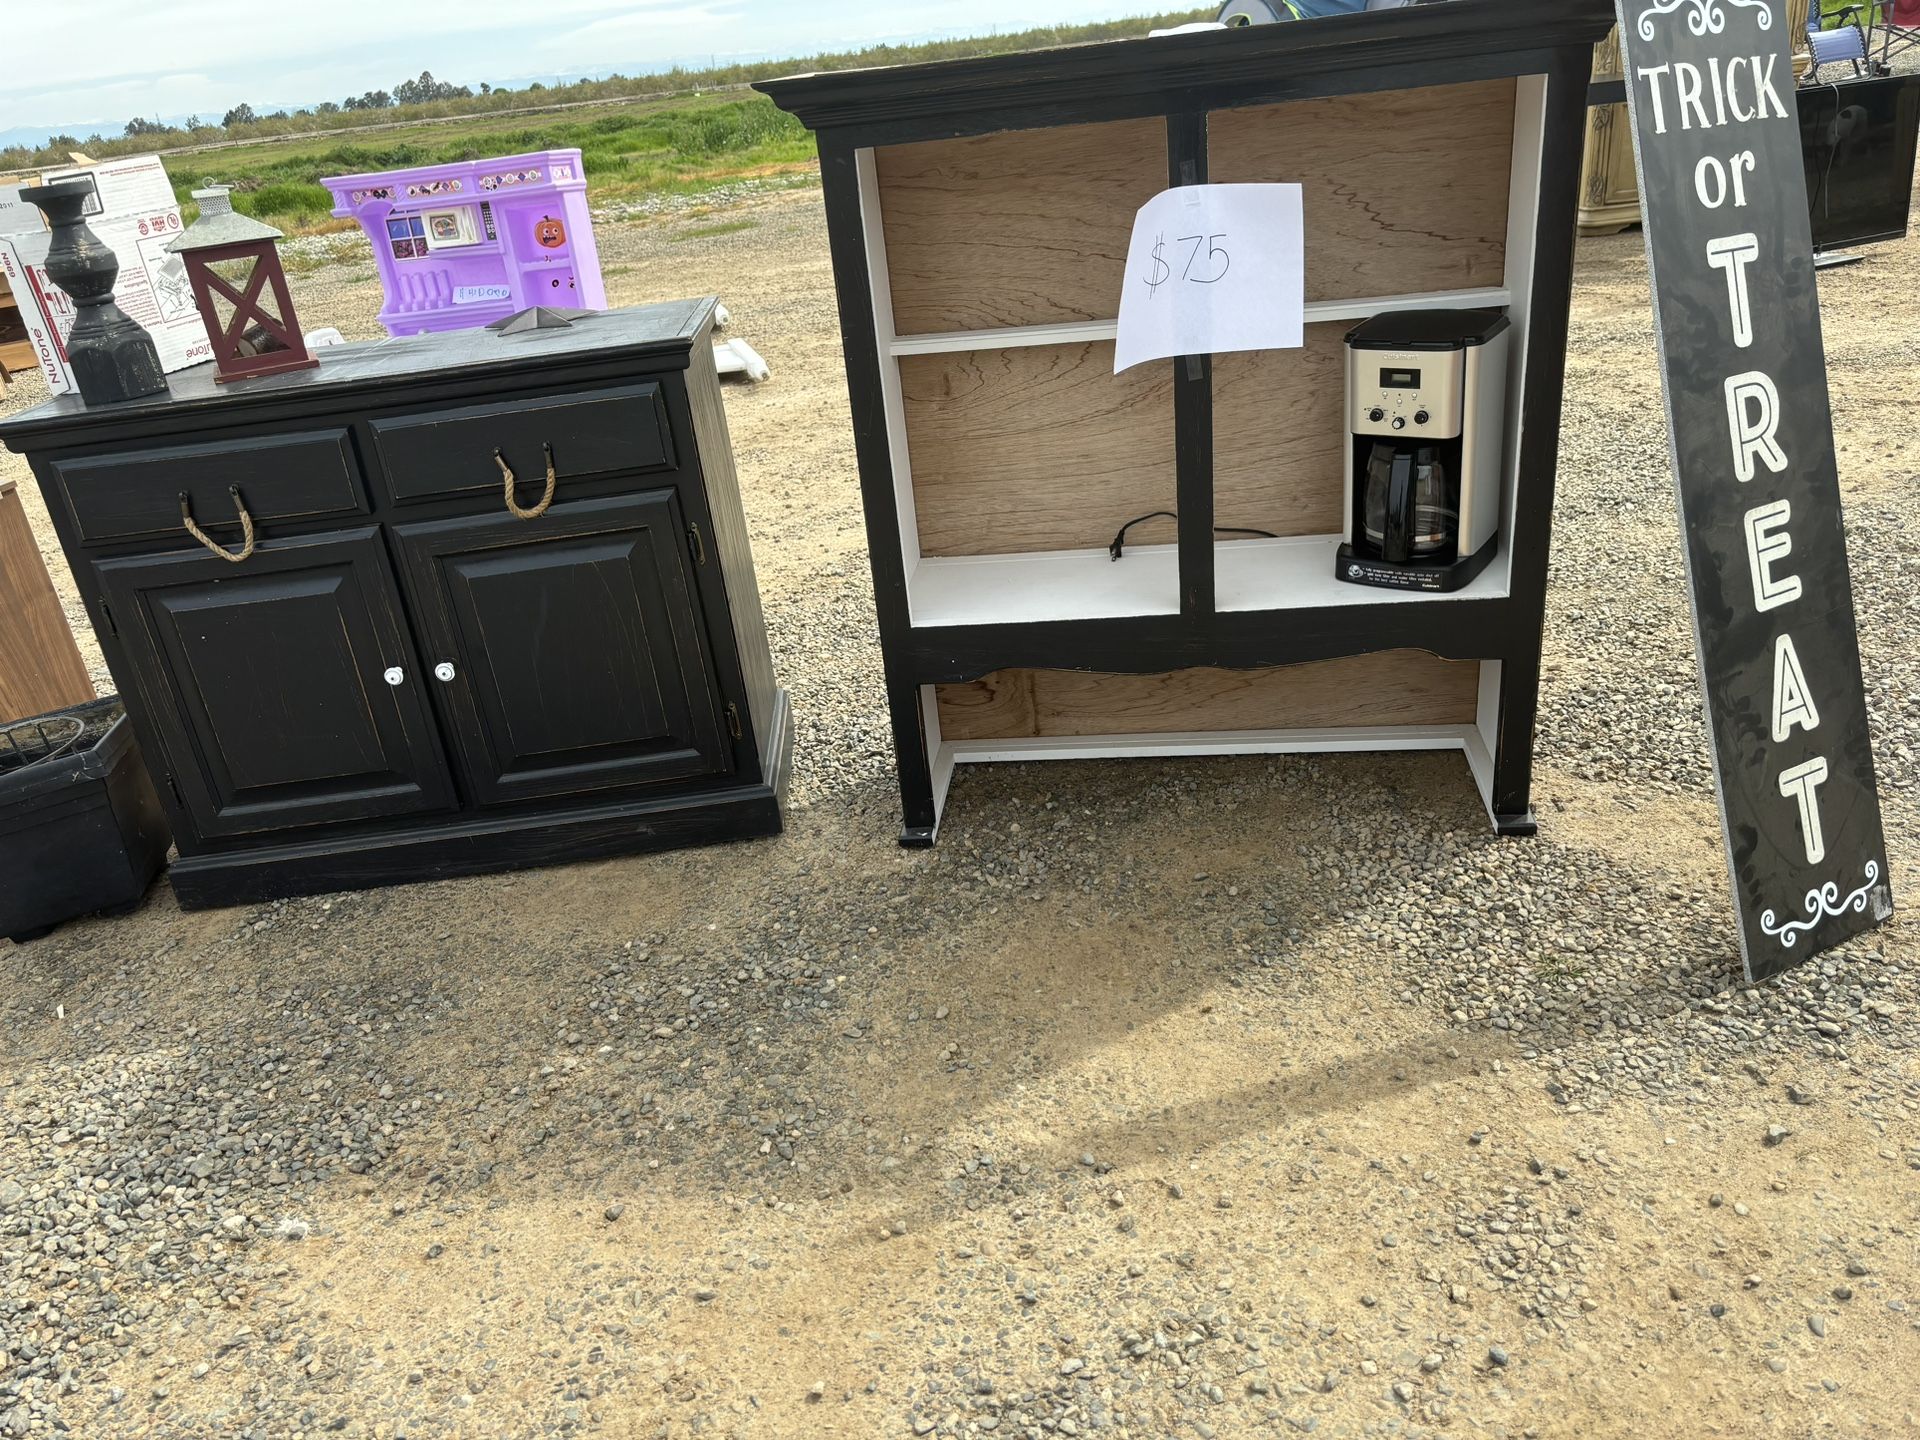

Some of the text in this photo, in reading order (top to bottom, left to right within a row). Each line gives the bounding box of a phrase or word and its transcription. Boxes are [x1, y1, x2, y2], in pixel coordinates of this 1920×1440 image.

[1637, 53, 1789, 134] TRICK
[1694, 150, 1755, 209] or
[1143, 231, 1229, 300] $75
[33, 328, 61, 384] NuTone
[185, 342, 212, 359] uTone
[1705, 232, 1829, 865] TREAT
